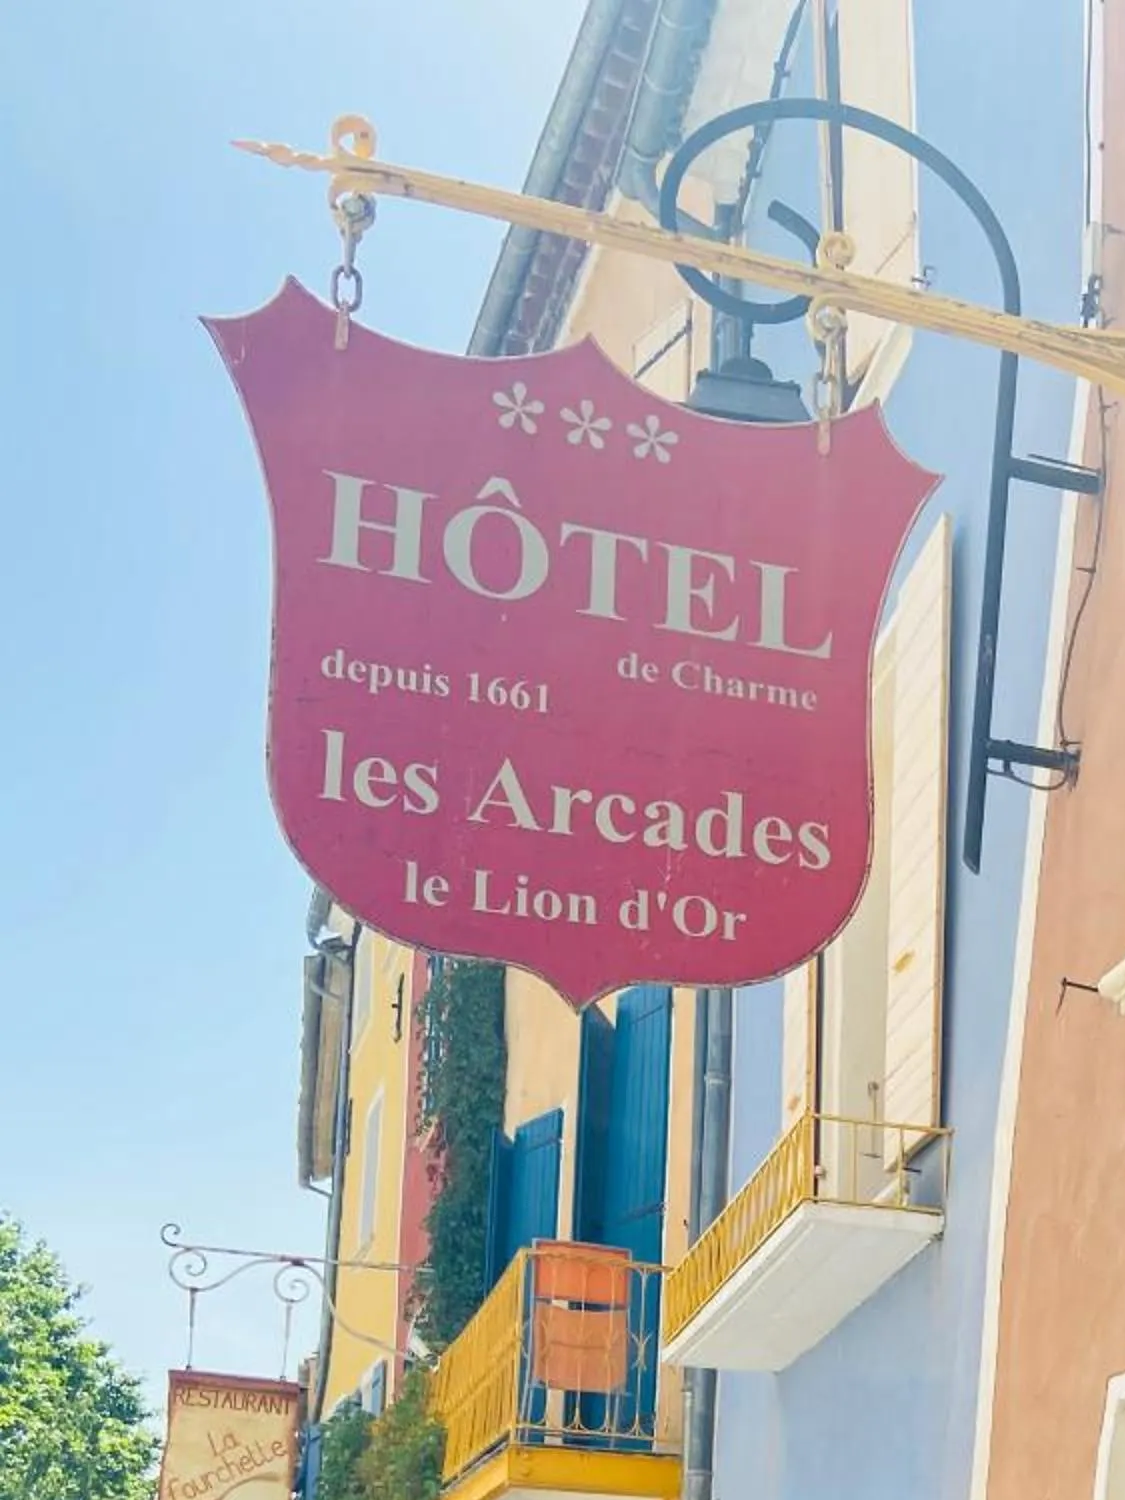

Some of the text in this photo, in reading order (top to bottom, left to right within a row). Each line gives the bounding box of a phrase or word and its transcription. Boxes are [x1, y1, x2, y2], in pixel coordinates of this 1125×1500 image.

[316, 469, 833, 660] HÔTEL
[320, 649, 550, 713] depuis 1661
[617, 653, 818, 711] de Charme
[319, 729, 832, 870] les Arcades
[404, 862, 747, 941] le Lion d'Or
[174, 1388, 290, 1415] RESTAURANT
